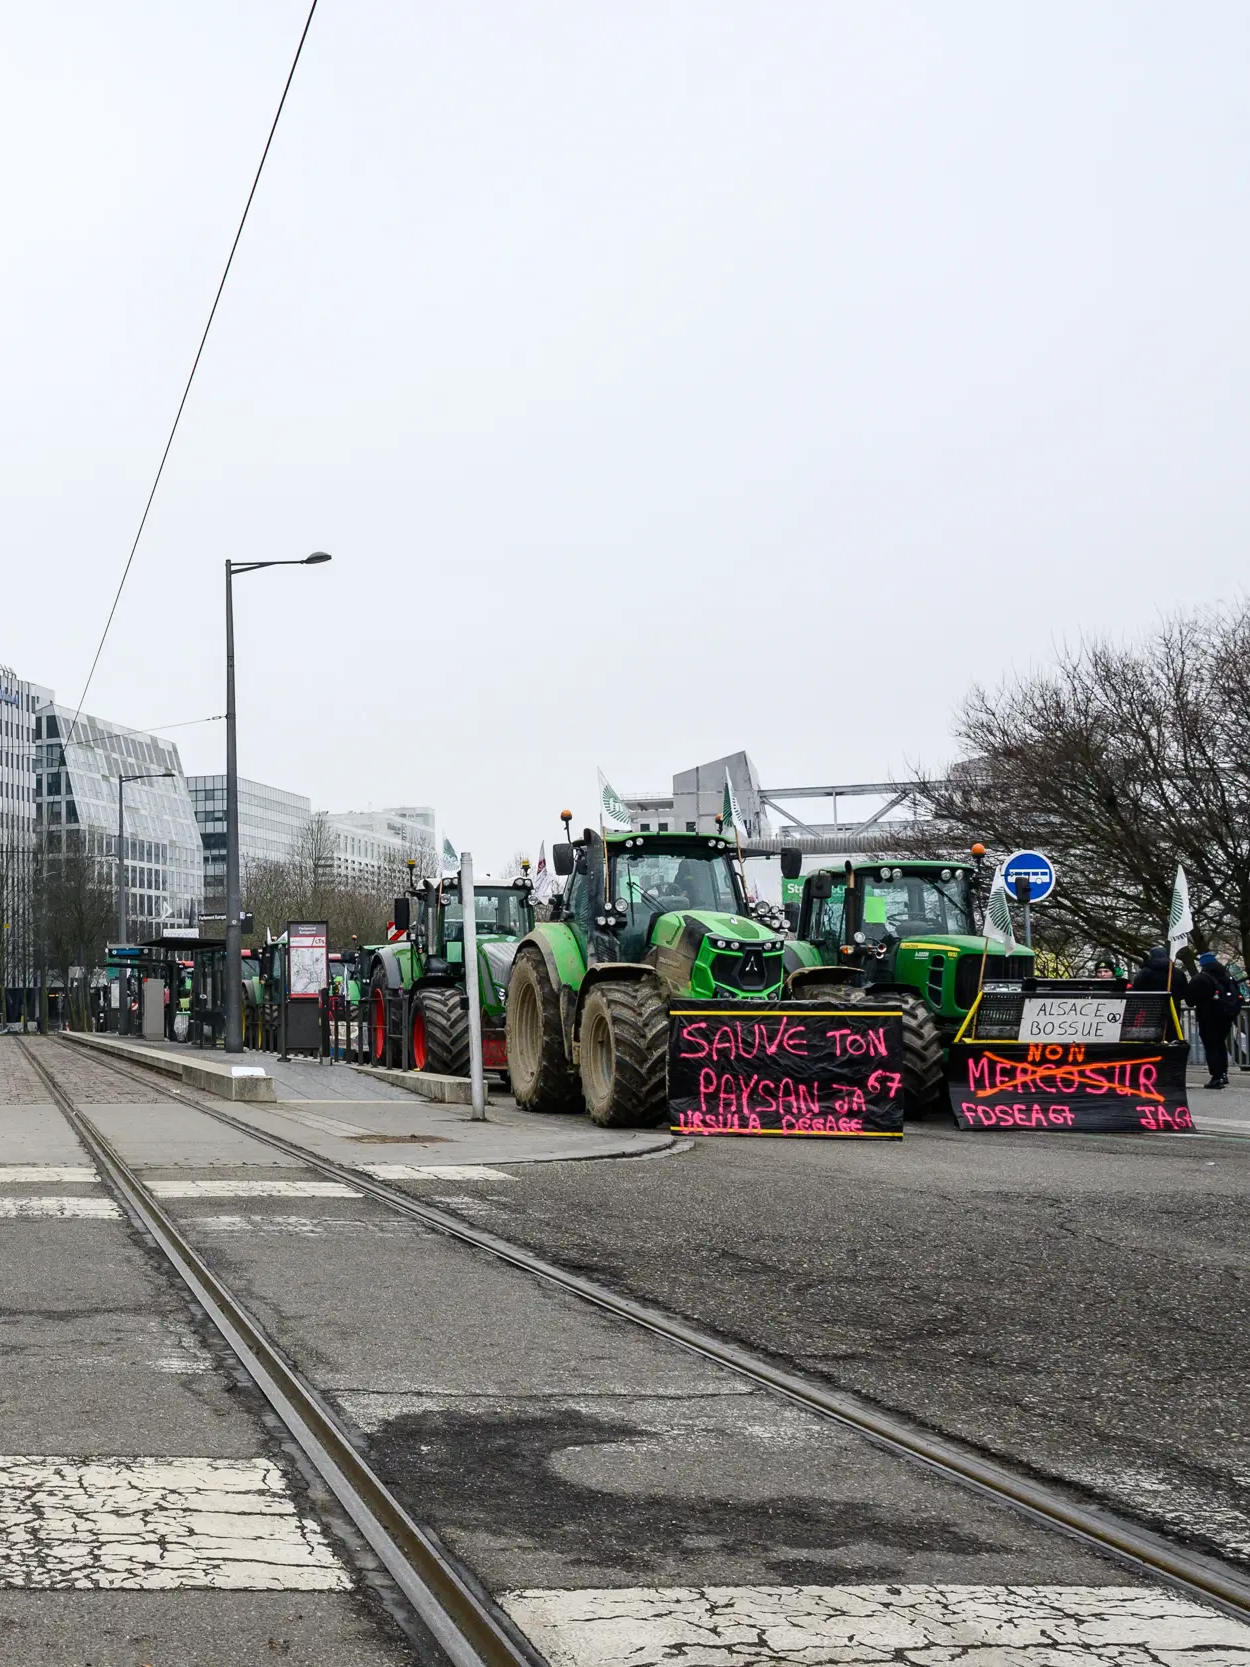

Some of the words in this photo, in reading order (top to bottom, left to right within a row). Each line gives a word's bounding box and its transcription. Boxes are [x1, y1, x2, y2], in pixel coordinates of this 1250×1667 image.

[1036, 1001, 1107, 1018] ALSACE
[679, 1016, 809, 1062] SAUVE
[826, 1027, 888, 1057] TON
[1030, 1020, 1105, 1037] BOSSUE
[1027, 1042, 1086, 1063] NON
[967, 1056, 1160, 1098] MERCOSUR
[699, 1067, 821, 1115] PAYSAN
[679, 1110, 762, 1136] URSULA
